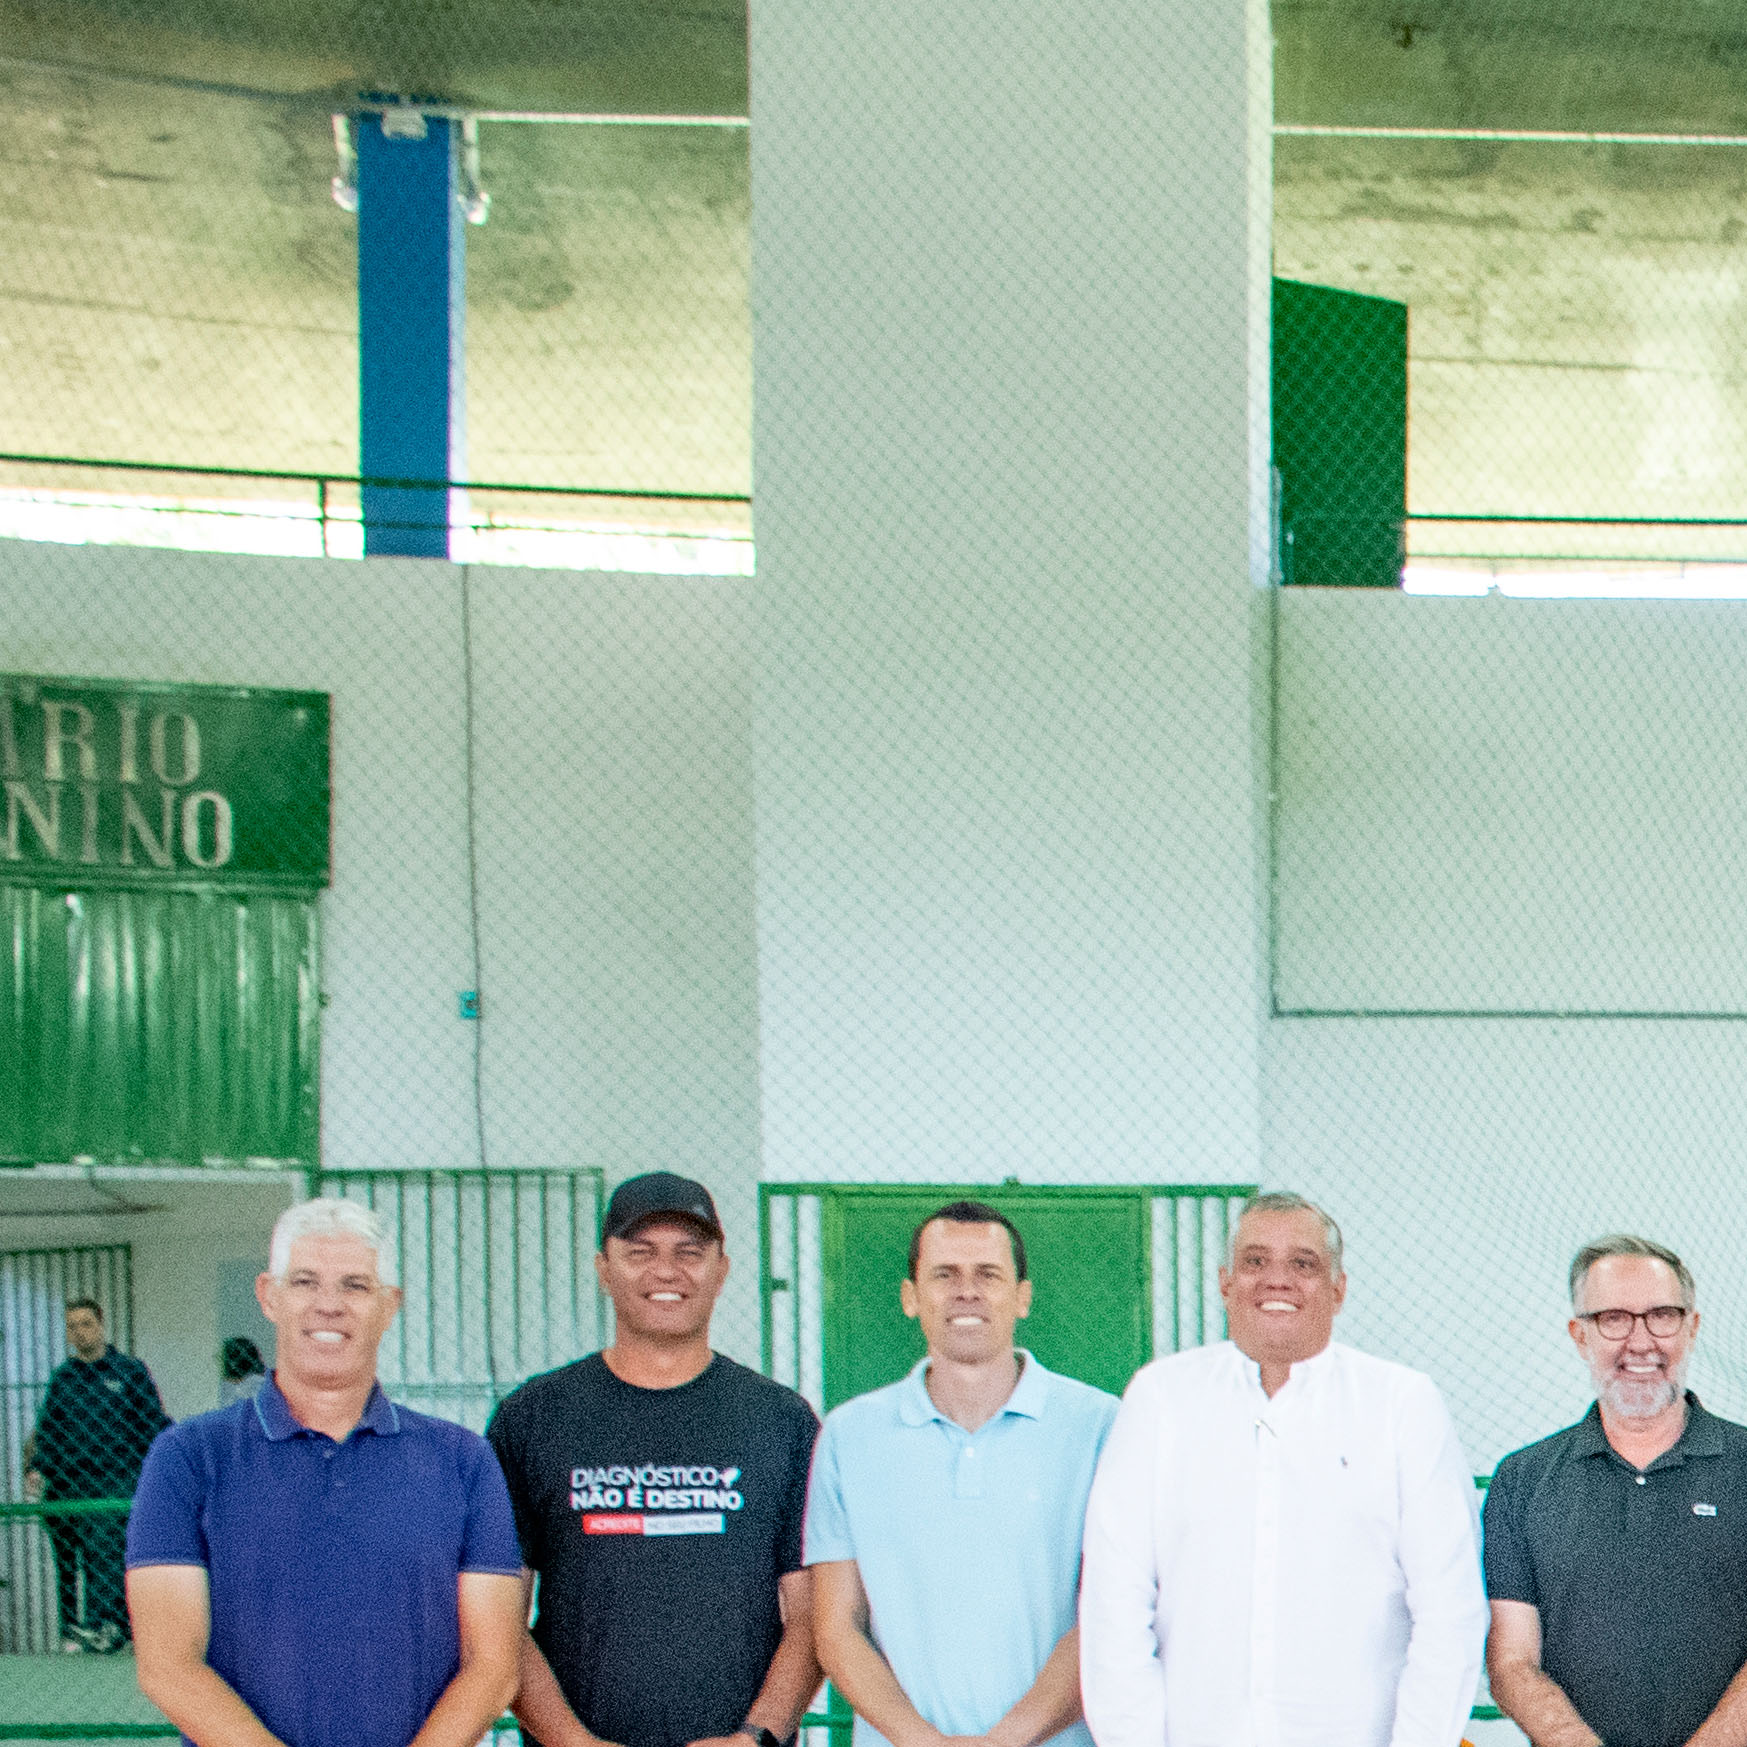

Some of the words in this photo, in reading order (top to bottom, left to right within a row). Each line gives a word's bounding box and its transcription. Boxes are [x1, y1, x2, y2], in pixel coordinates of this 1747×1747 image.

[571, 1463, 718, 1488] DIAGNÓSTICO
[571, 1486, 624, 1510] NÃO
[627, 1485, 644, 1509] É
[645, 1489, 744, 1511] DESTINO
